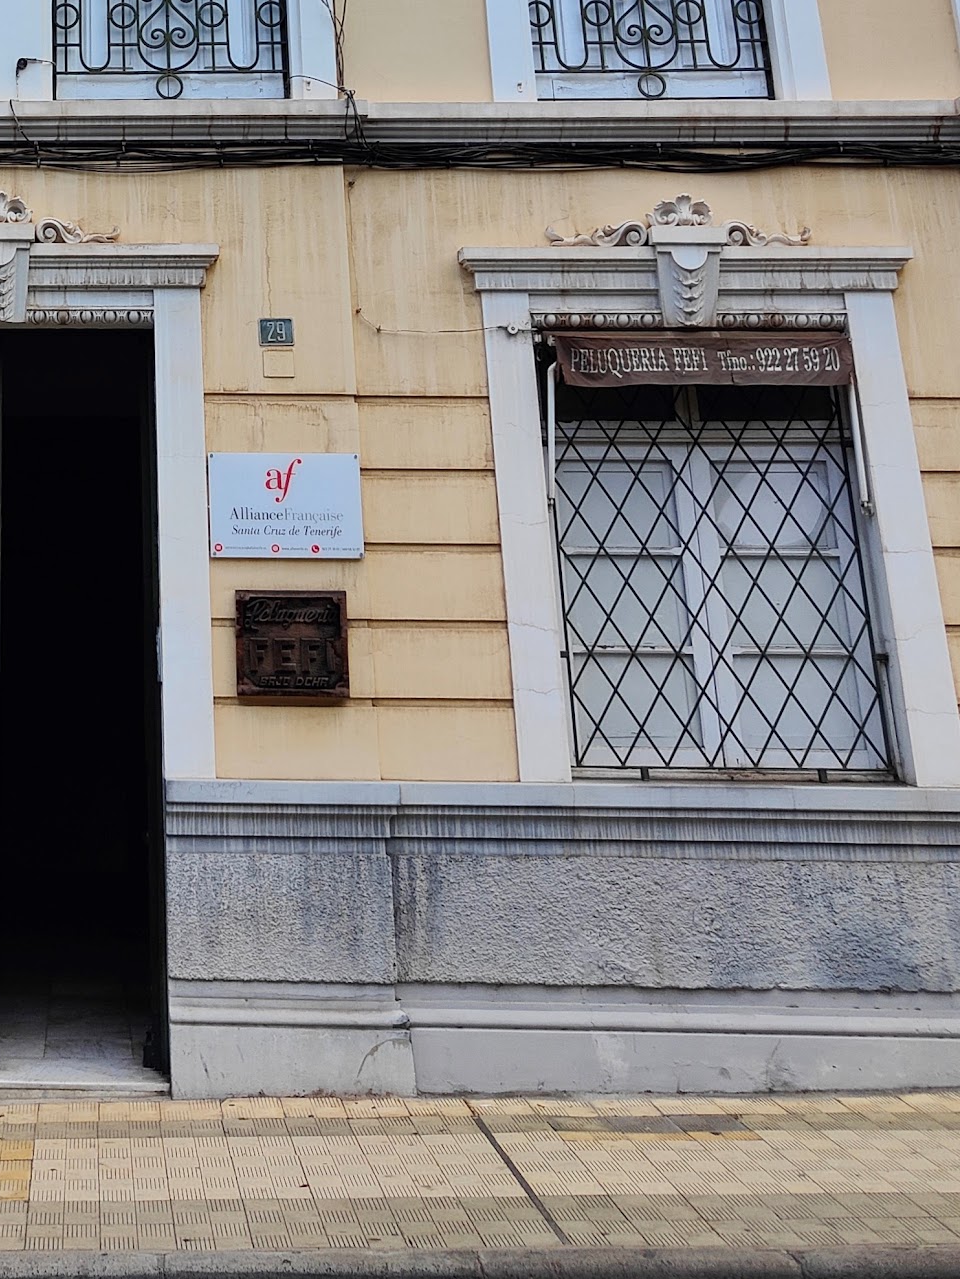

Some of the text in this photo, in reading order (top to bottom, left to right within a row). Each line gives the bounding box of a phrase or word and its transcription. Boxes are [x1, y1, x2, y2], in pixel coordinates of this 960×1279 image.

[267, 321, 286, 342] 29
[571, 347, 669, 378] PELUQUERIA
[672, 347, 708, 373] FEFI
[756, 348, 782, 372] 922
[783, 347, 799, 372] 27
[803, 347, 820, 372] 59
[822, 347, 841, 372] 20
[265, 458, 302, 503] af
[231, 524, 343, 539] Santa Cruz de Tenerife
[249, 638, 336, 674] FEFI
